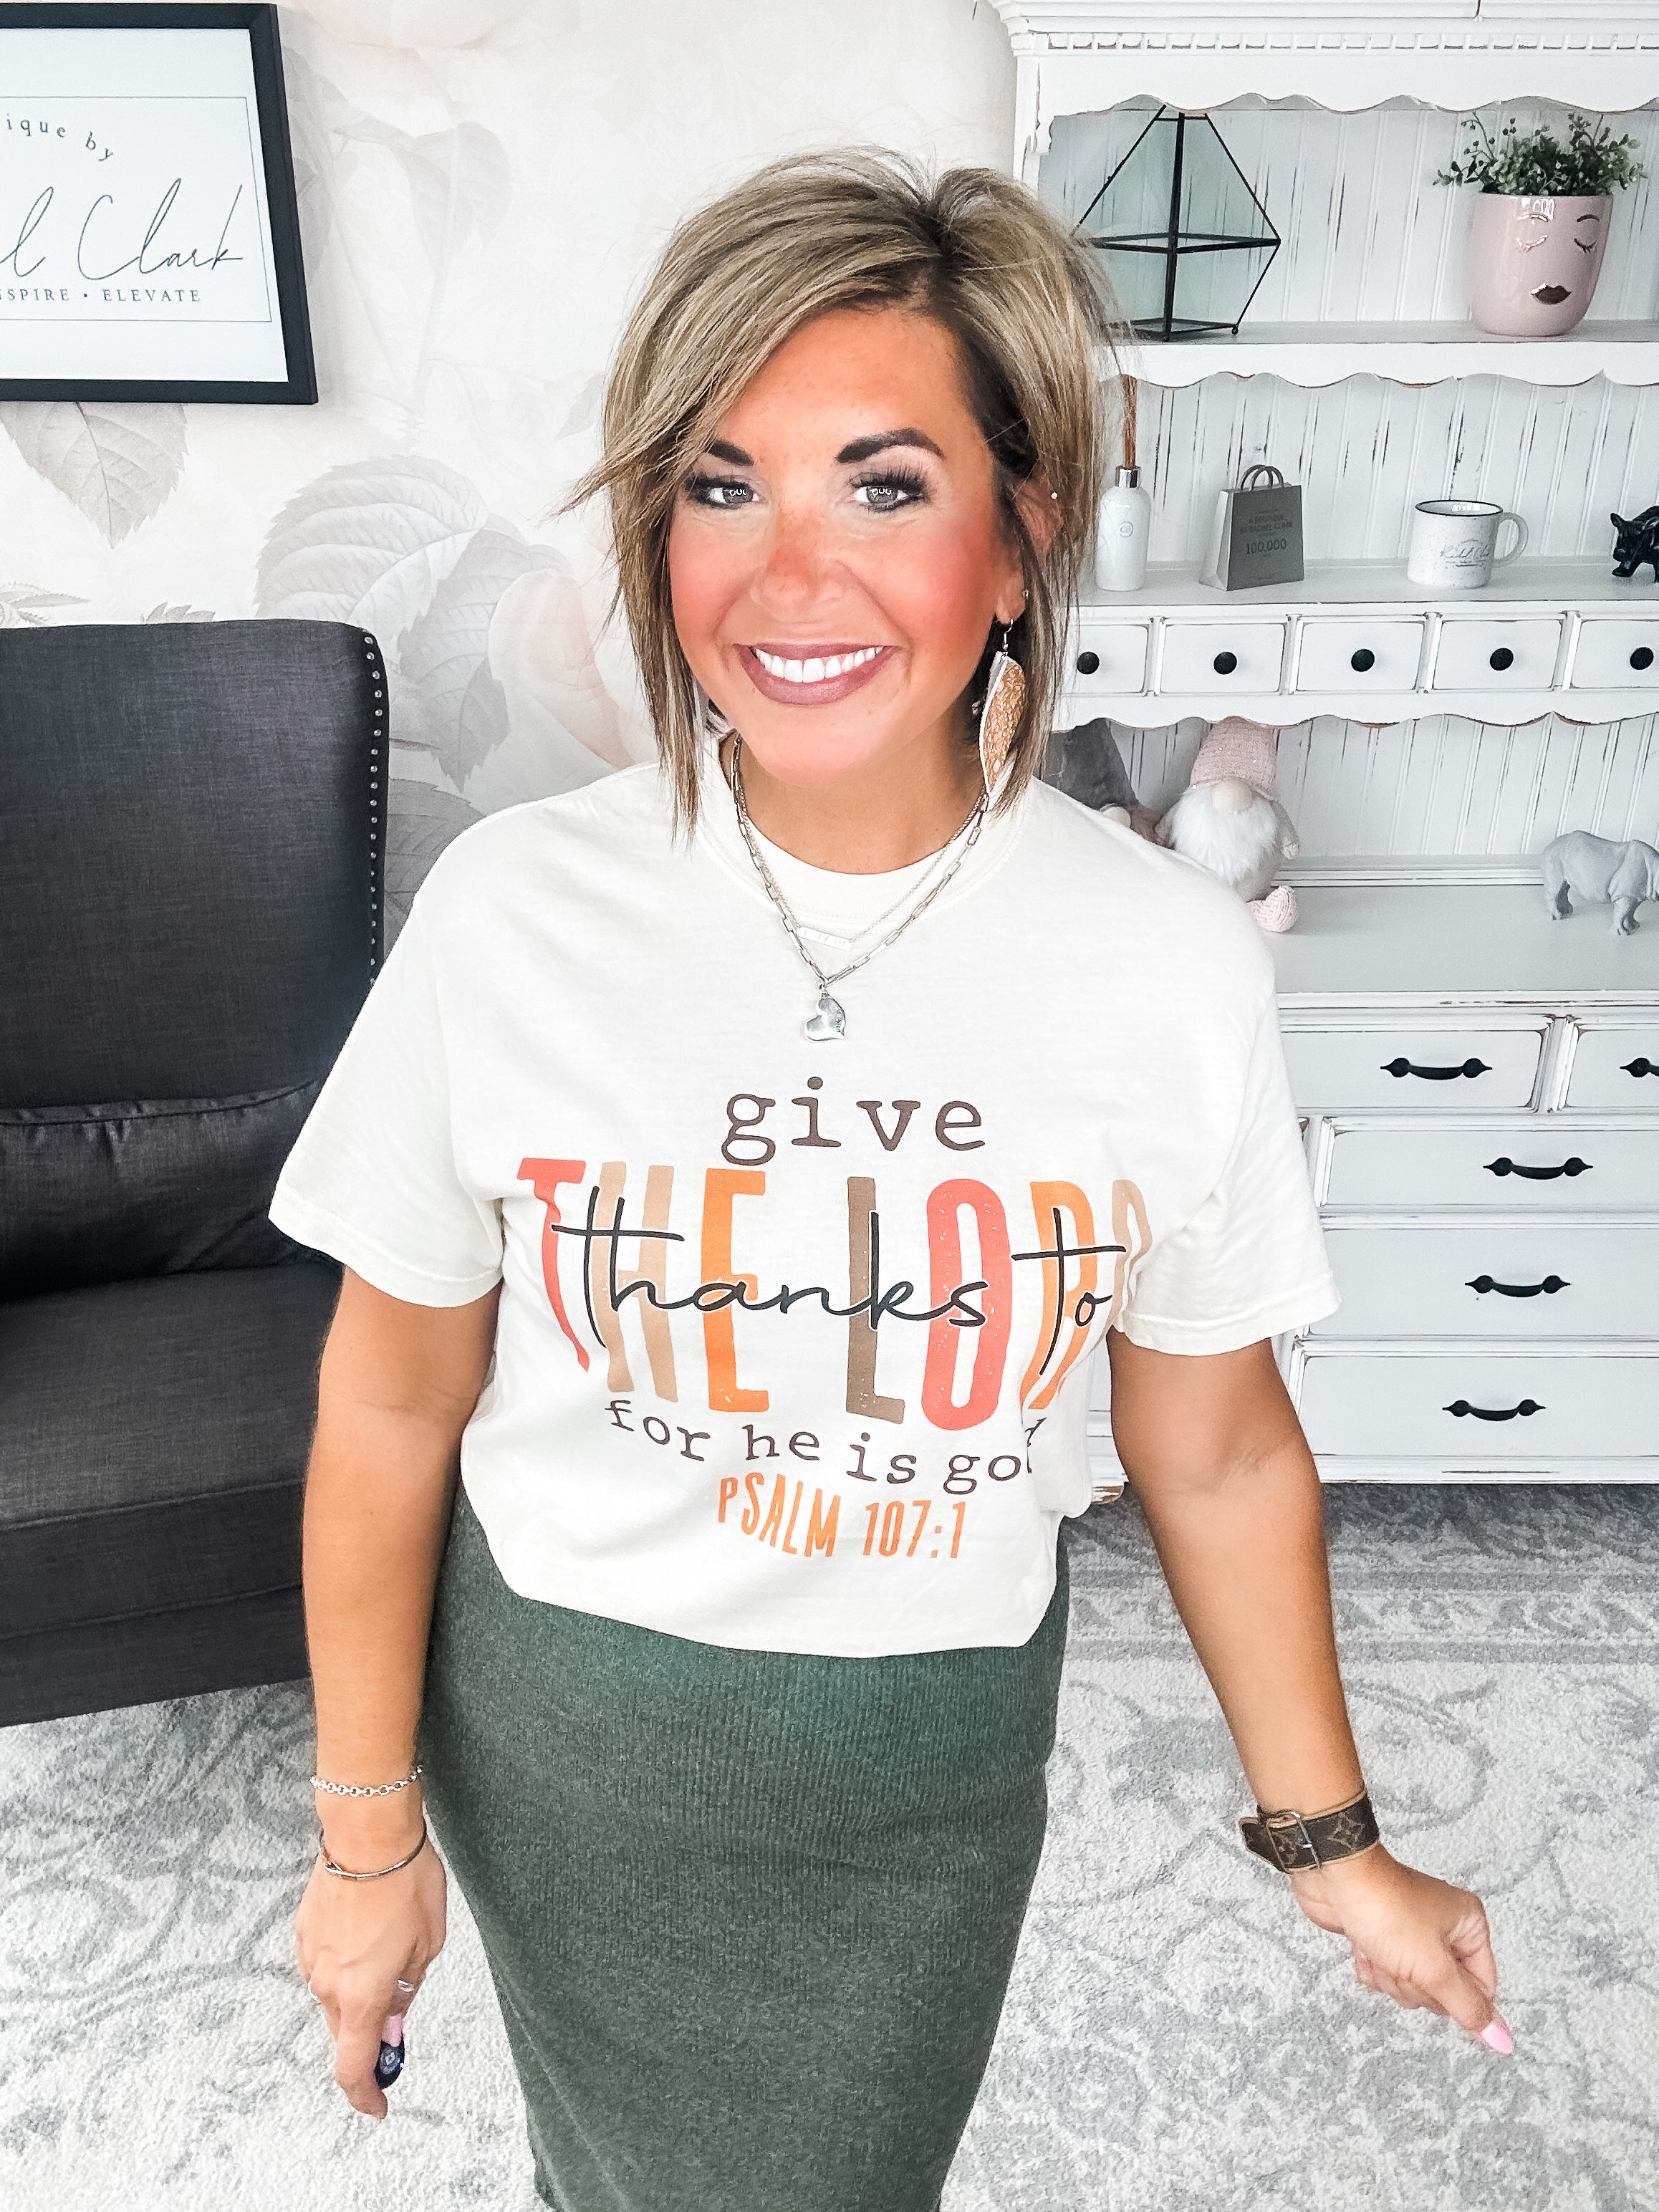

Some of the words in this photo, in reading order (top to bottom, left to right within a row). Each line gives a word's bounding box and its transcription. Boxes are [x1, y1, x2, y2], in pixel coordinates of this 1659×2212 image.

[85, 130, 114, 162] by
[77, 177, 244, 280] Clark
[102, 289, 201, 302] ELEVATE
[721, 1076, 986, 1167] give
[516, 1157, 769, 1413] THE
[550, 1186, 990, 1348] thanks
[1011, 1206, 1127, 1376] to
[605, 1399, 711, 1462] for
[741, 1423, 821, 1461] he
[845, 1432, 917, 1485] is
[942, 1416, 1047, 1496] go
[718, 1471, 842, 1558] PSALM
[863, 1499, 967, 1559] 107:1
